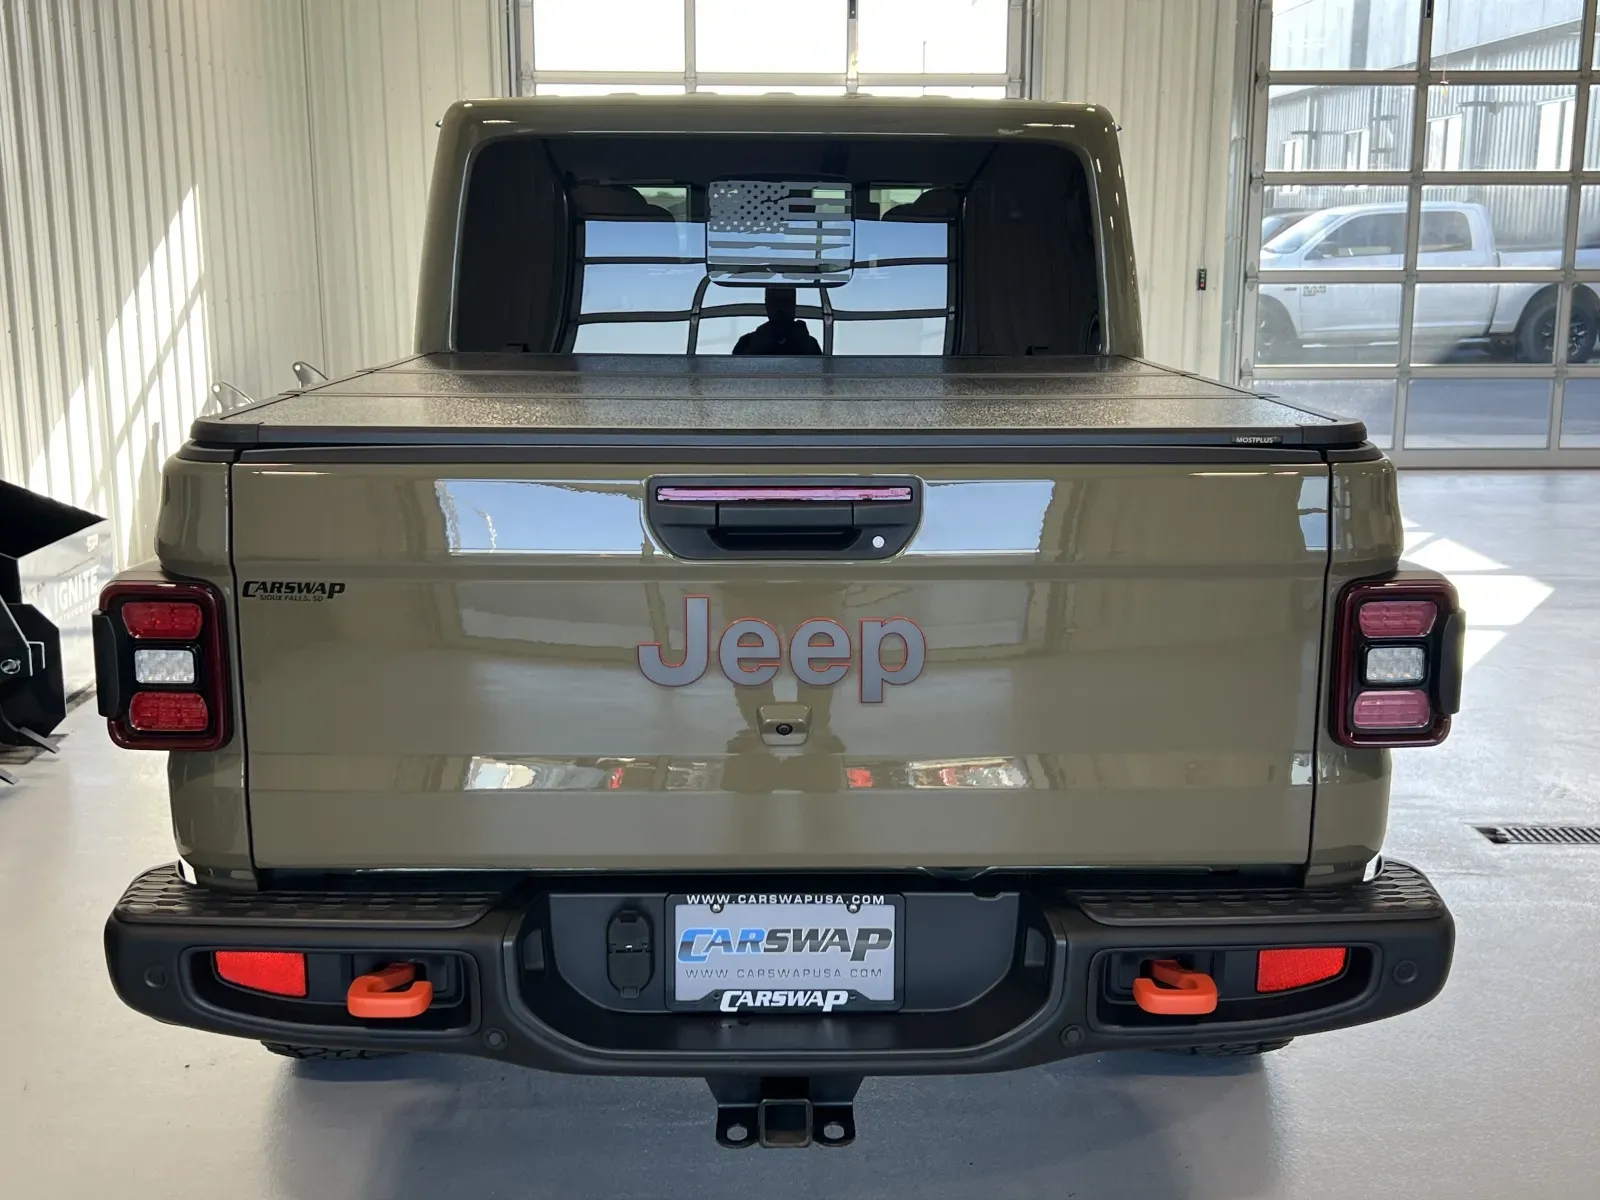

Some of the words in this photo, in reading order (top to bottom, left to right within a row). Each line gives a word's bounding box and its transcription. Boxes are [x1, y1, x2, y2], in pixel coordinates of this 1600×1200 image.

[242, 580, 346, 599] CARSWAP
[637, 593, 926, 704] Jeep
[686, 894, 885, 905] WWW.CARSWAPUSA.COM
[677, 927, 893, 963] CARSWAP
[719, 990, 848, 1012] CARSWAP
